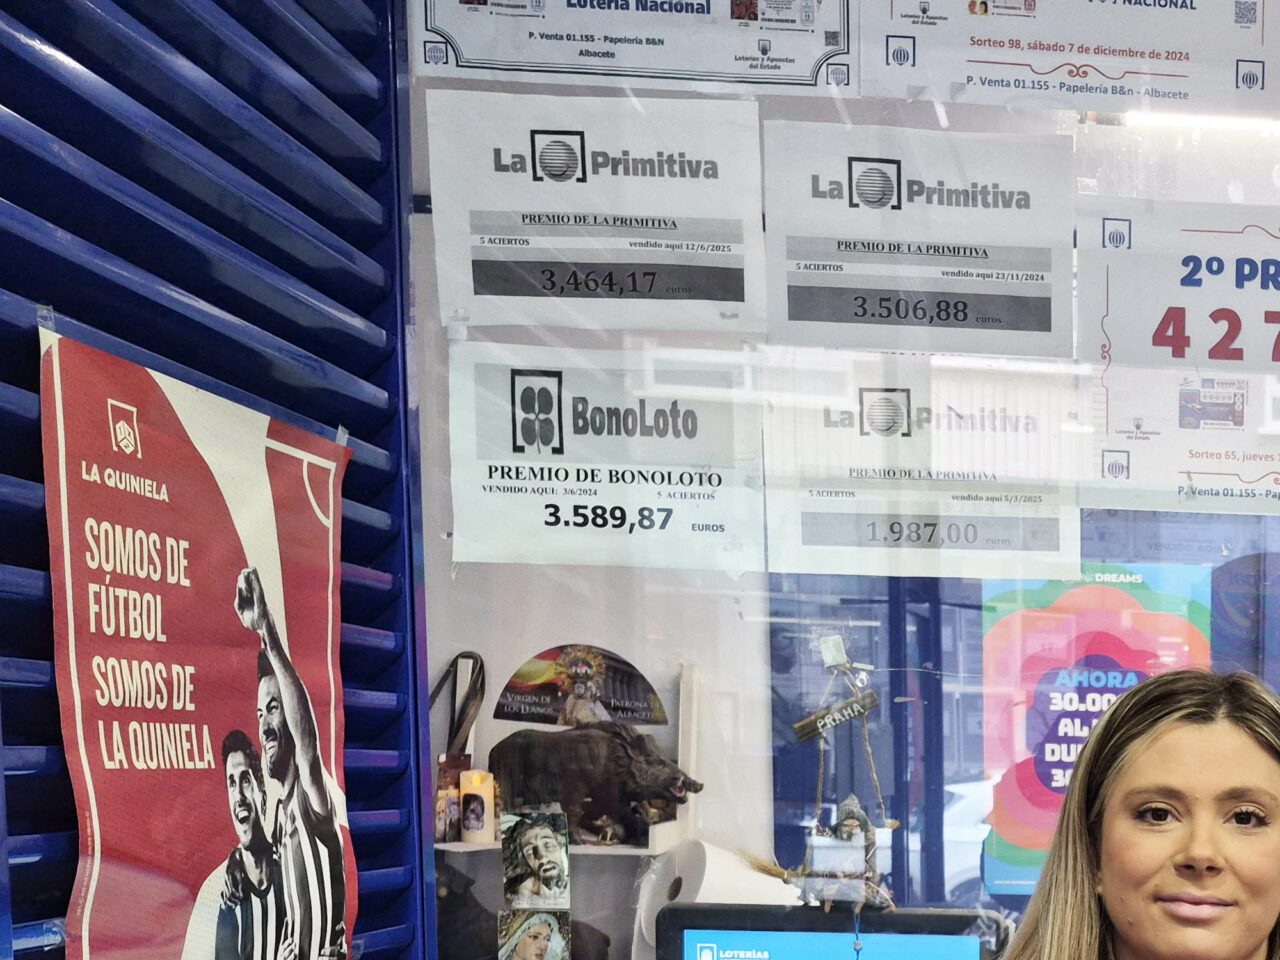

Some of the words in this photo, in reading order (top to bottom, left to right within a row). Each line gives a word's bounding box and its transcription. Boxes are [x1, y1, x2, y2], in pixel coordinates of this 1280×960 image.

[528, 32, 537, 40] P.
[539, 33, 564, 41] Venta
[566, 33, 595, 42] 01.155
[645, 36, 664, 46] B&N
[969, 36, 1006, 49] Sorteo
[1008, 38, 1025, 52] 98,
[1027, 38, 1066, 53] sábado
[1069, 43, 1075, 54] 7
[1077, 43, 1091, 55] de
[1093, 44, 1147, 58] diciembre
[1149, 47, 1162, 59] de
[1164, 50, 1190, 62] 2024
[578, 49, 616, 59] Albacete
[492, 148, 527, 173] La
[591, 150, 719, 179] Primitiva
[811, 174, 844, 199] La
[906, 179, 1031, 210] Primitiva
[521, 214, 571, 225] PREMIO
[574, 214, 590, 225] DE
[593, 215, 609, 226] LA
[613, 216, 678, 229] PRIMITIVA
[480, 237, 485, 245] 5
[487, 238, 530, 246] ACIERTOS
[540, 268, 657, 295] 3,464,17
[1180, 255, 1225, 288] 2º
[853, 295, 968, 324] 3.506,88
[572, 396, 698, 439] BonoLoto
[823, 406, 855, 429] La
[916, 406, 1038, 433] Primitiva
[81, 460, 101, 484] LA
[104, 466, 169, 502] QUINIELA
[487, 464, 569, 483] PREMIO
[576, 468, 602, 484] DE
[608, 469, 722, 487] BONOLOTO
[481, 485, 528, 495] VENDIDO
[563, 487, 598, 497] 3/6/2024
[544, 503, 674, 534] 3.589,87
[691, 523, 725, 533] EUROS
[866, 521, 978, 546] 1.987,00
[84, 517, 162, 582] SOMOS
[166, 536, 191, 587] DE
[1096, 573, 1143, 583] DREAMS
[87, 575, 167, 642] FÚTBOL
[91, 655, 168, 711] SOMOS
[172, 663, 196, 711] DE
[1054, 670, 1139, 688] AHORA
[817, 703, 864, 732] PRAHA
[98, 720, 124, 770] LA
[131, 723, 215, 769] QUINIELA
[719, 949, 770, 960] LOTERÍAS
